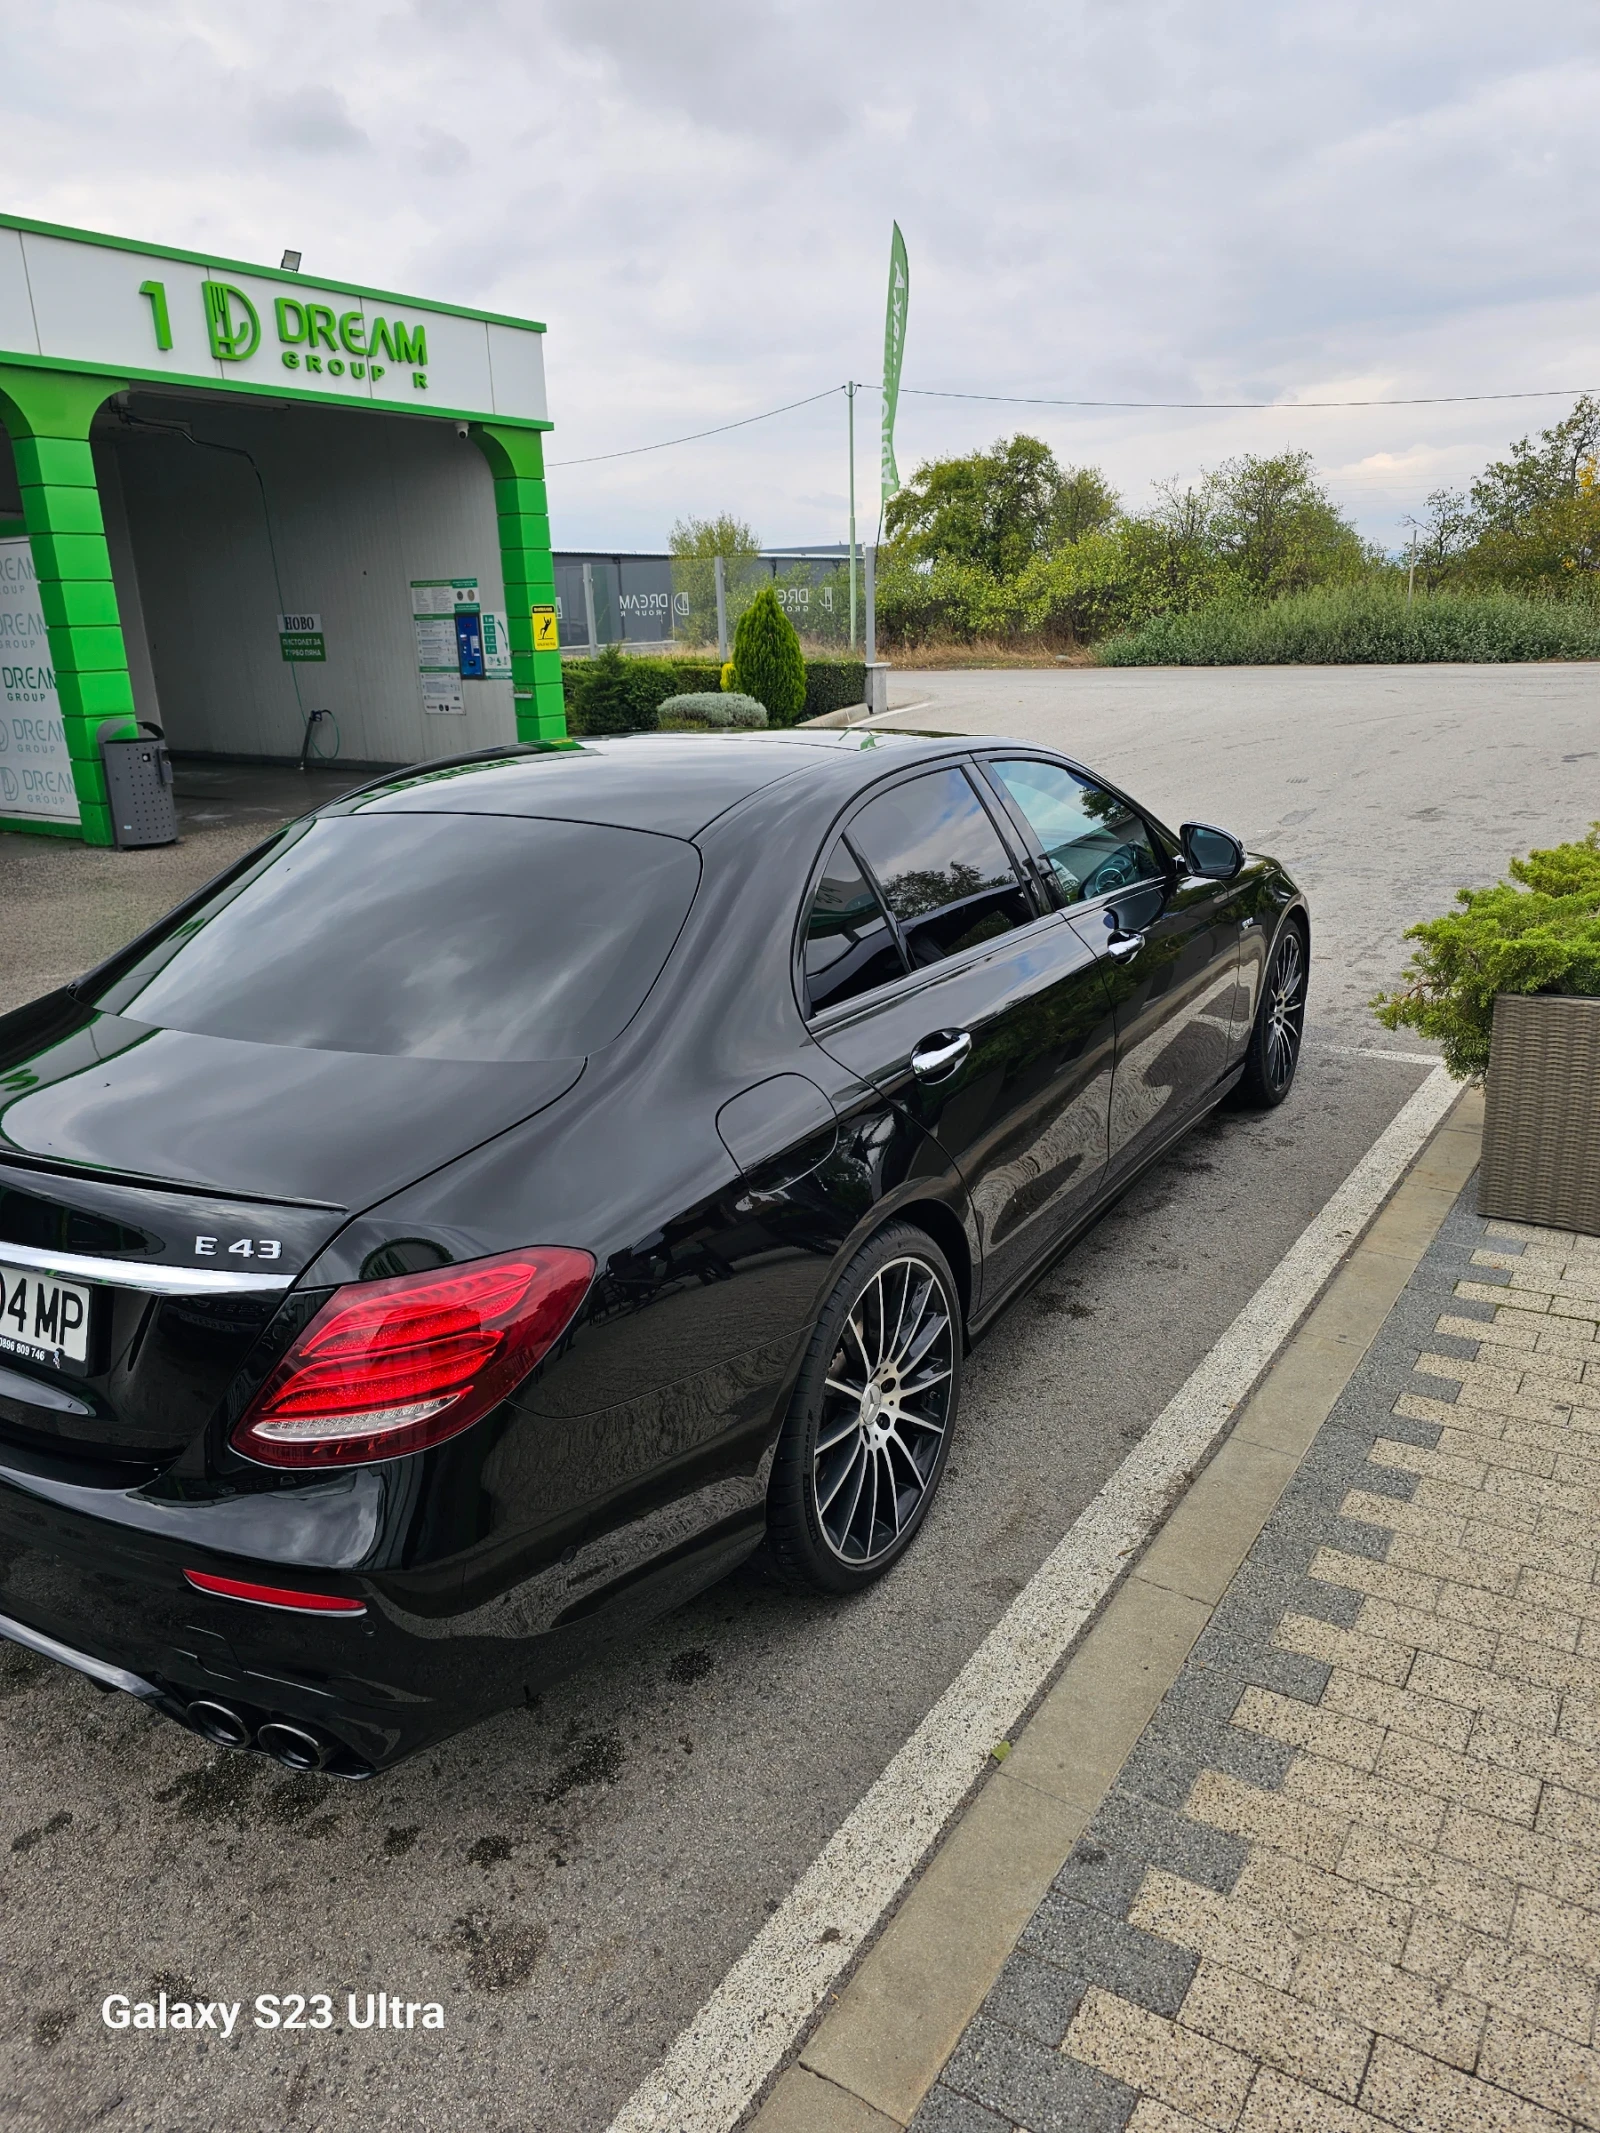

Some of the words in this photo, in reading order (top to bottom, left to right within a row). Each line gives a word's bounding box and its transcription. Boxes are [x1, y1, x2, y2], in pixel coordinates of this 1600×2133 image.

[139, 280, 173, 350] 1
[274, 297, 428, 366] DREAM
[281, 350, 385, 382] GROUP
[413, 371, 428, 389] R
[0, 585, 25, 595] OUP
[284, 616, 314, 630] НОВО
[7, 692, 46, 702] GROUP
[17, 744, 56, 753] GROUP
[195, 1235, 218, 1256] E
[228, 1238, 282, 1259] 43
[0, 1270, 27, 1333] 4
[34, 1282, 84, 1347] MP
[16, 1342, 30, 1356] 809
[31, 1347, 45, 1361] 746
